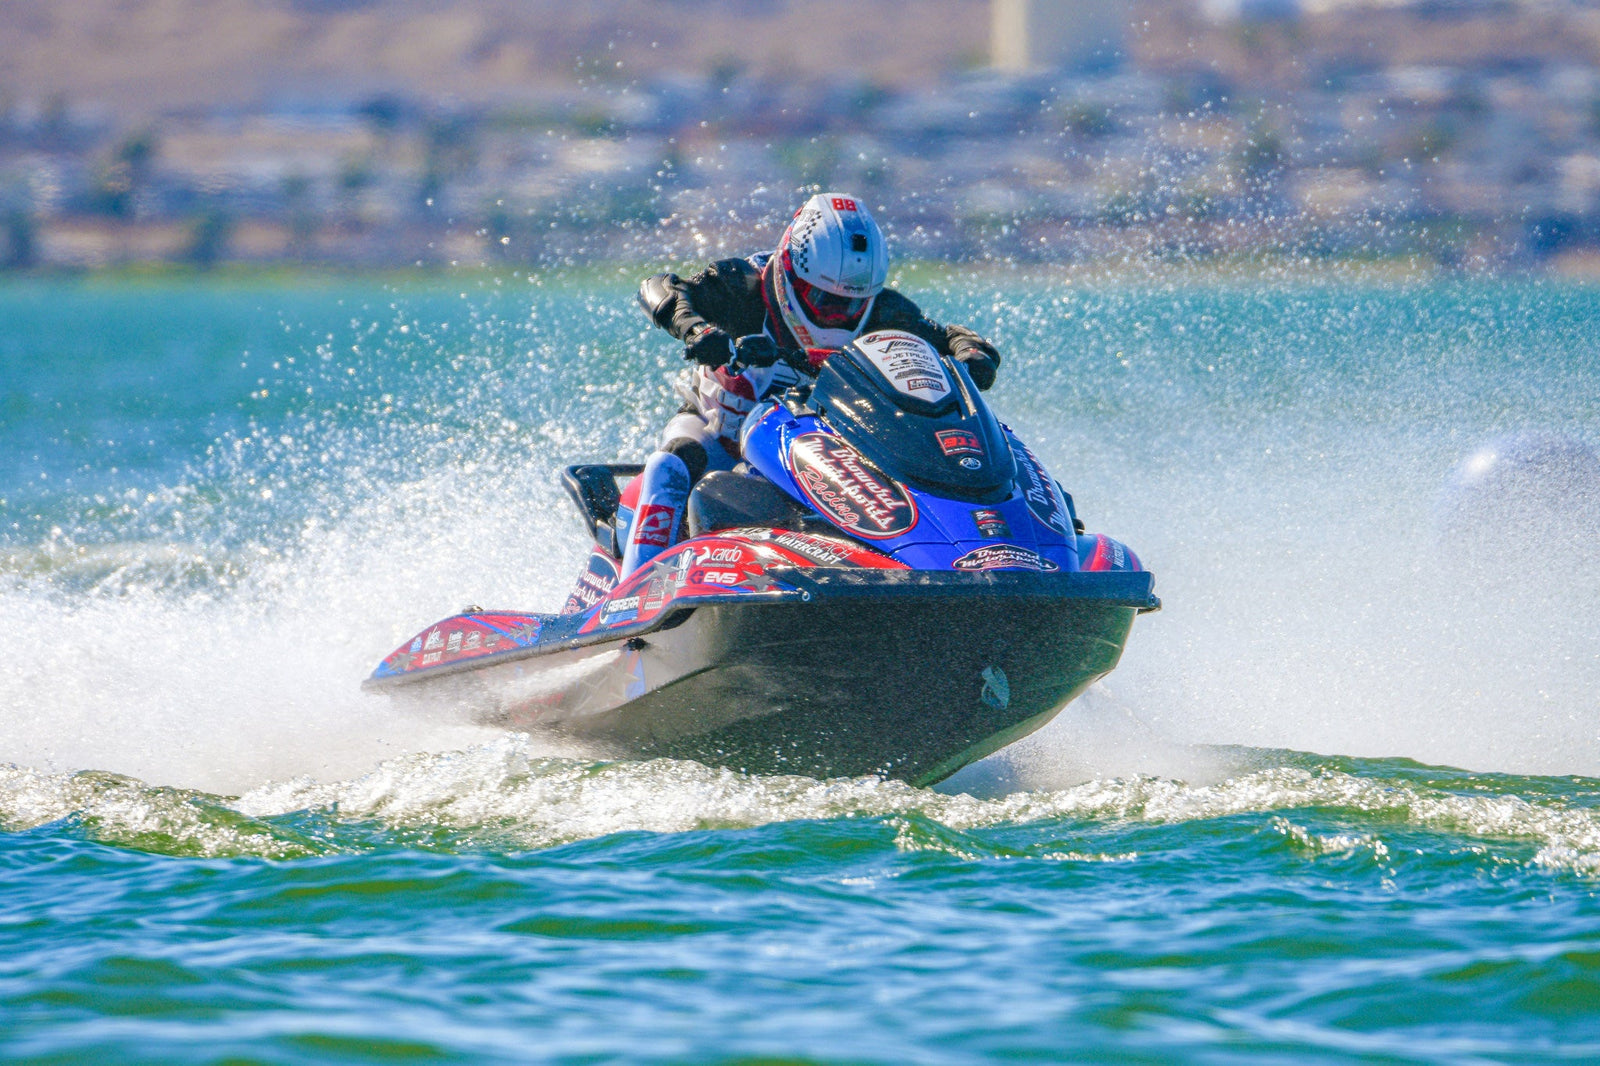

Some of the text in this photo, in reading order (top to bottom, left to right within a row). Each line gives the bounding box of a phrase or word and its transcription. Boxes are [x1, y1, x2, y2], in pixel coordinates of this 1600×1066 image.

[799, 464, 860, 527] Racing
[830, 447, 907, 510] Broward
[711, 546, 742, 562] cardo
[775, 535, 842, 564] WATERCRAFT
